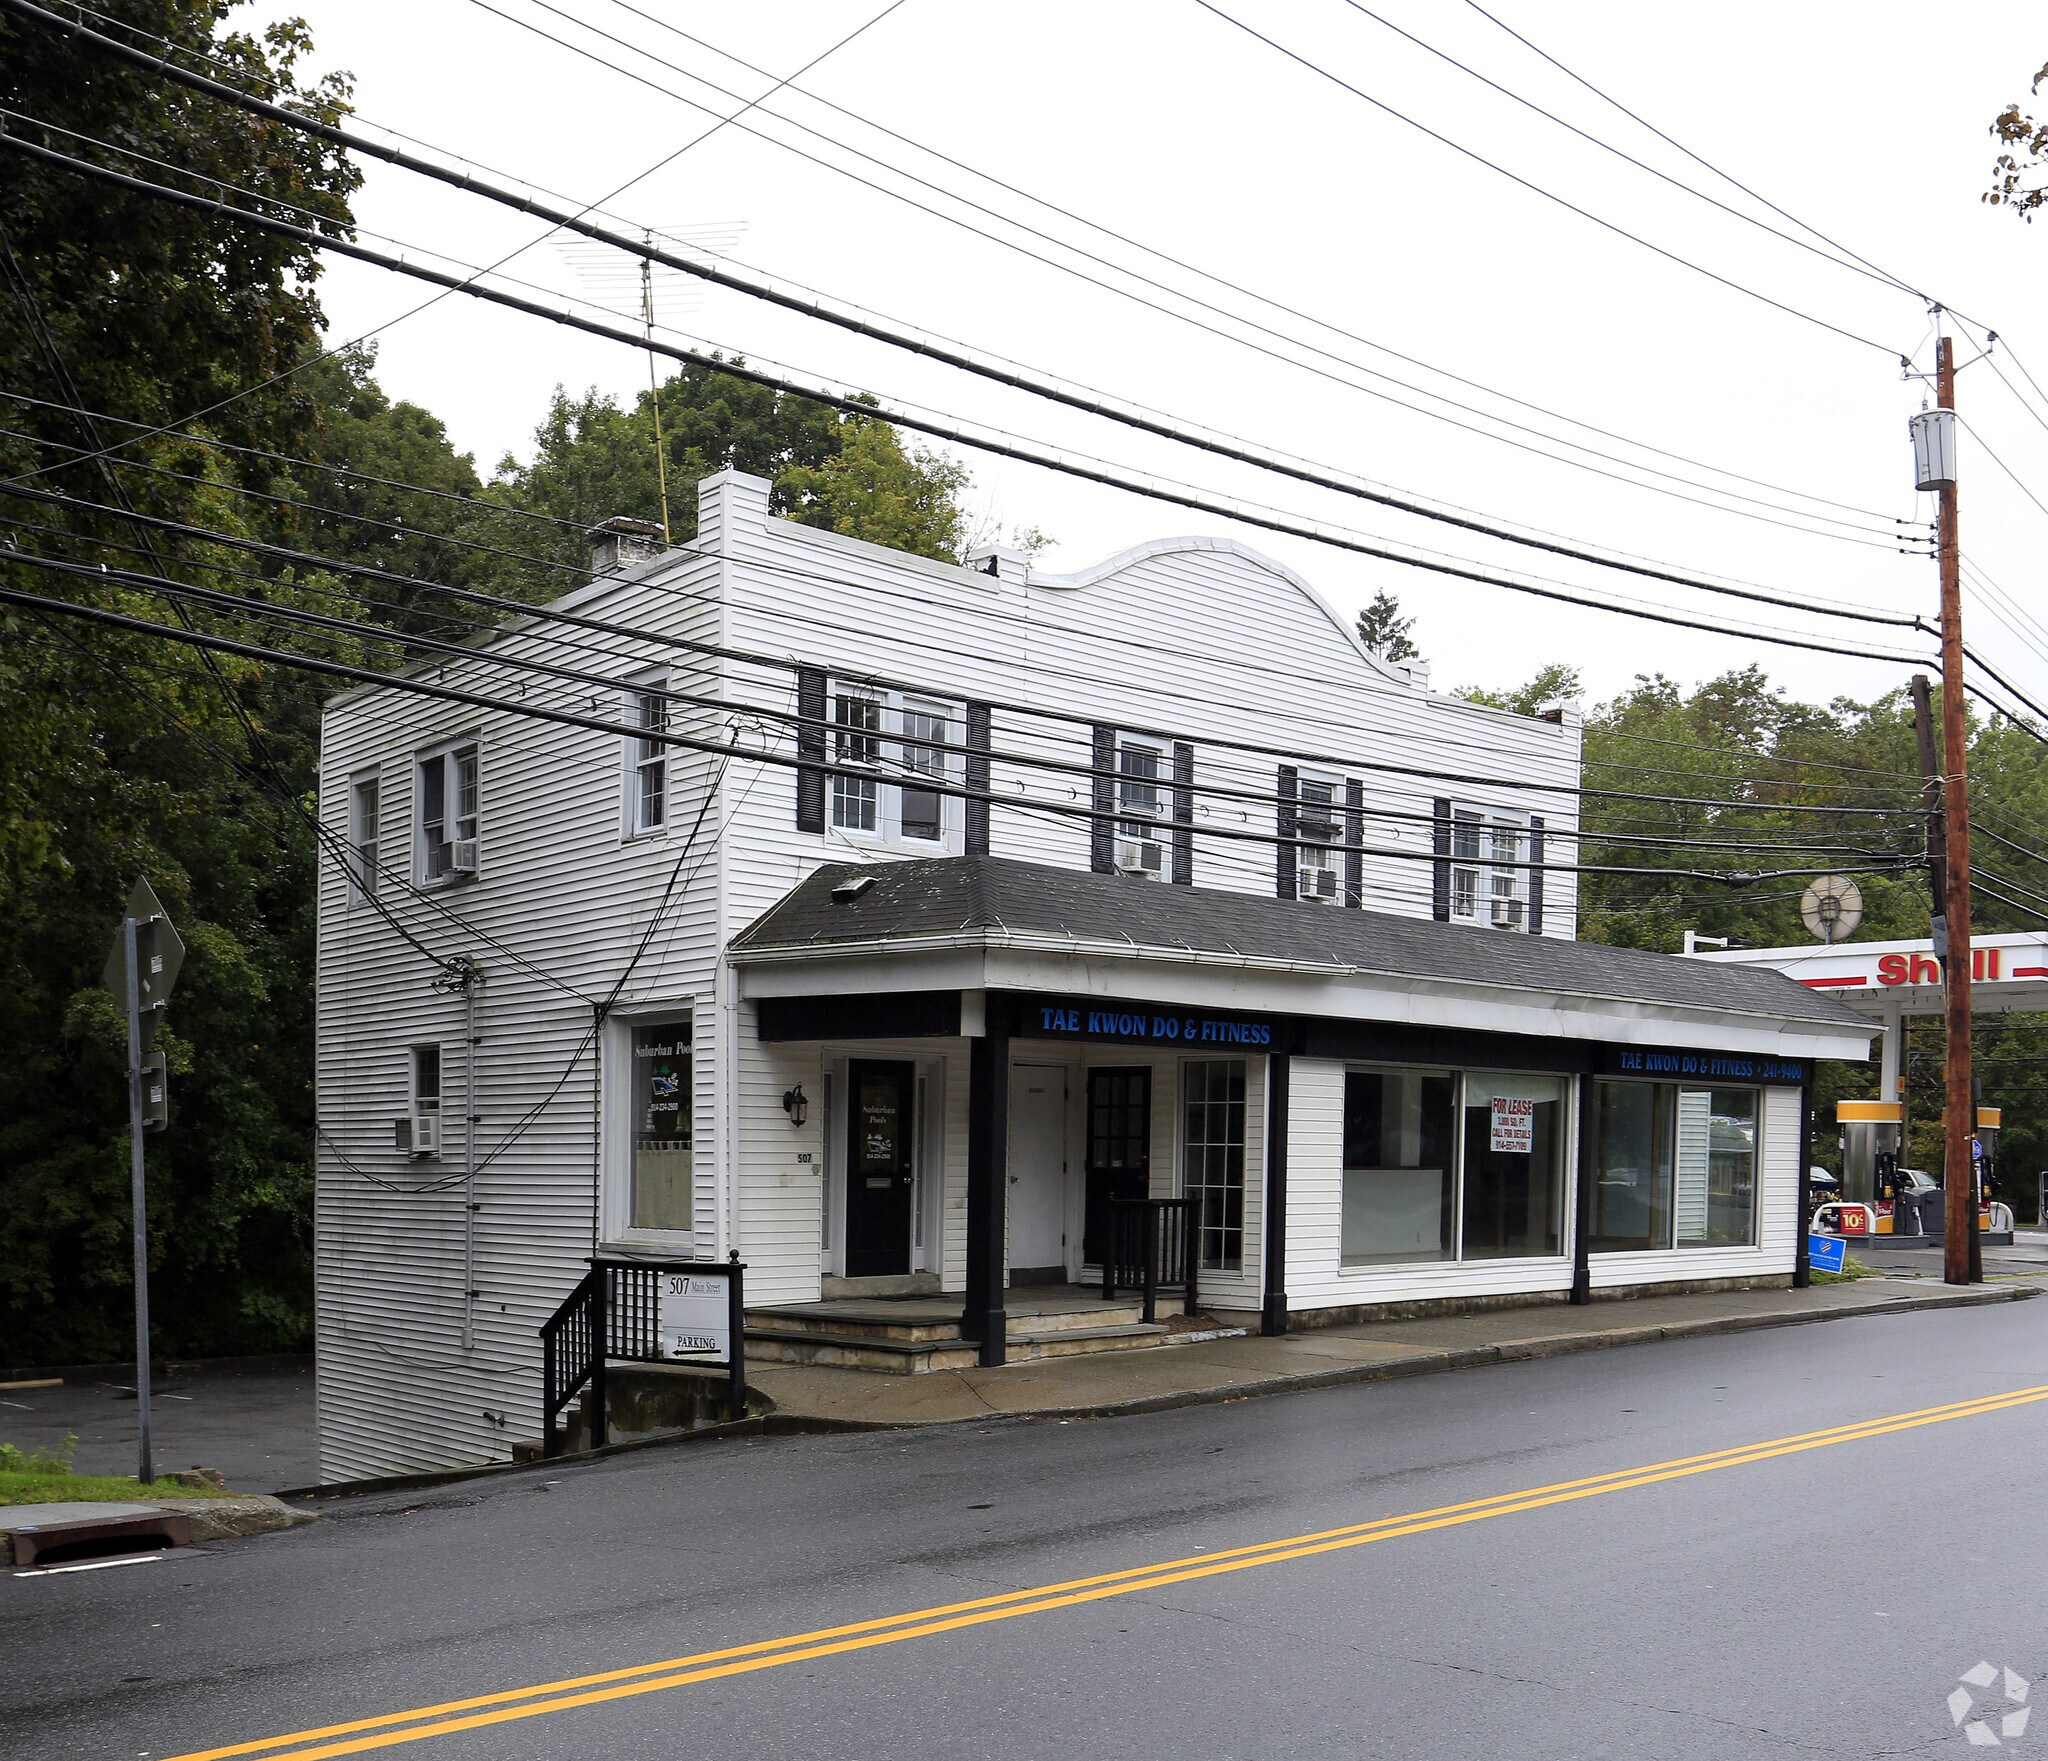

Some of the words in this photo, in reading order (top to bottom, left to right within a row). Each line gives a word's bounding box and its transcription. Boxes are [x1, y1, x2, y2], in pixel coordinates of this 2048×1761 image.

[1877, 949, 1999, 985] Shll
[1040, 1008, 1080, 1032] TAE
[1088, 1011, 1146, 1036] KWON
[1152, 1017, 1179, 1039] DO
[1184, 1019, 1197, 1040] &
[1201, 1020, 1271, 1045] FITNESS
[635, 1043, 672, 1058] Suburban
[1620, 1052, 1642, 1070] TAE
[1646, 1053, 1679, 1072] KWON
[1682, 1056, 1698, 1073] DO
[1701, 1058, 1708, 1074] &
[1711, 1058, 1754, 1077] FITNESS
[1492, 1098, 1507, 1114] FOR
[1508, 1099, 1532, 1115] LEASE
[797, 1154, 812, 1163] 507
[669, 1277, 690, 1295] 507
[677, 1336, 716, 1349] PARKING
